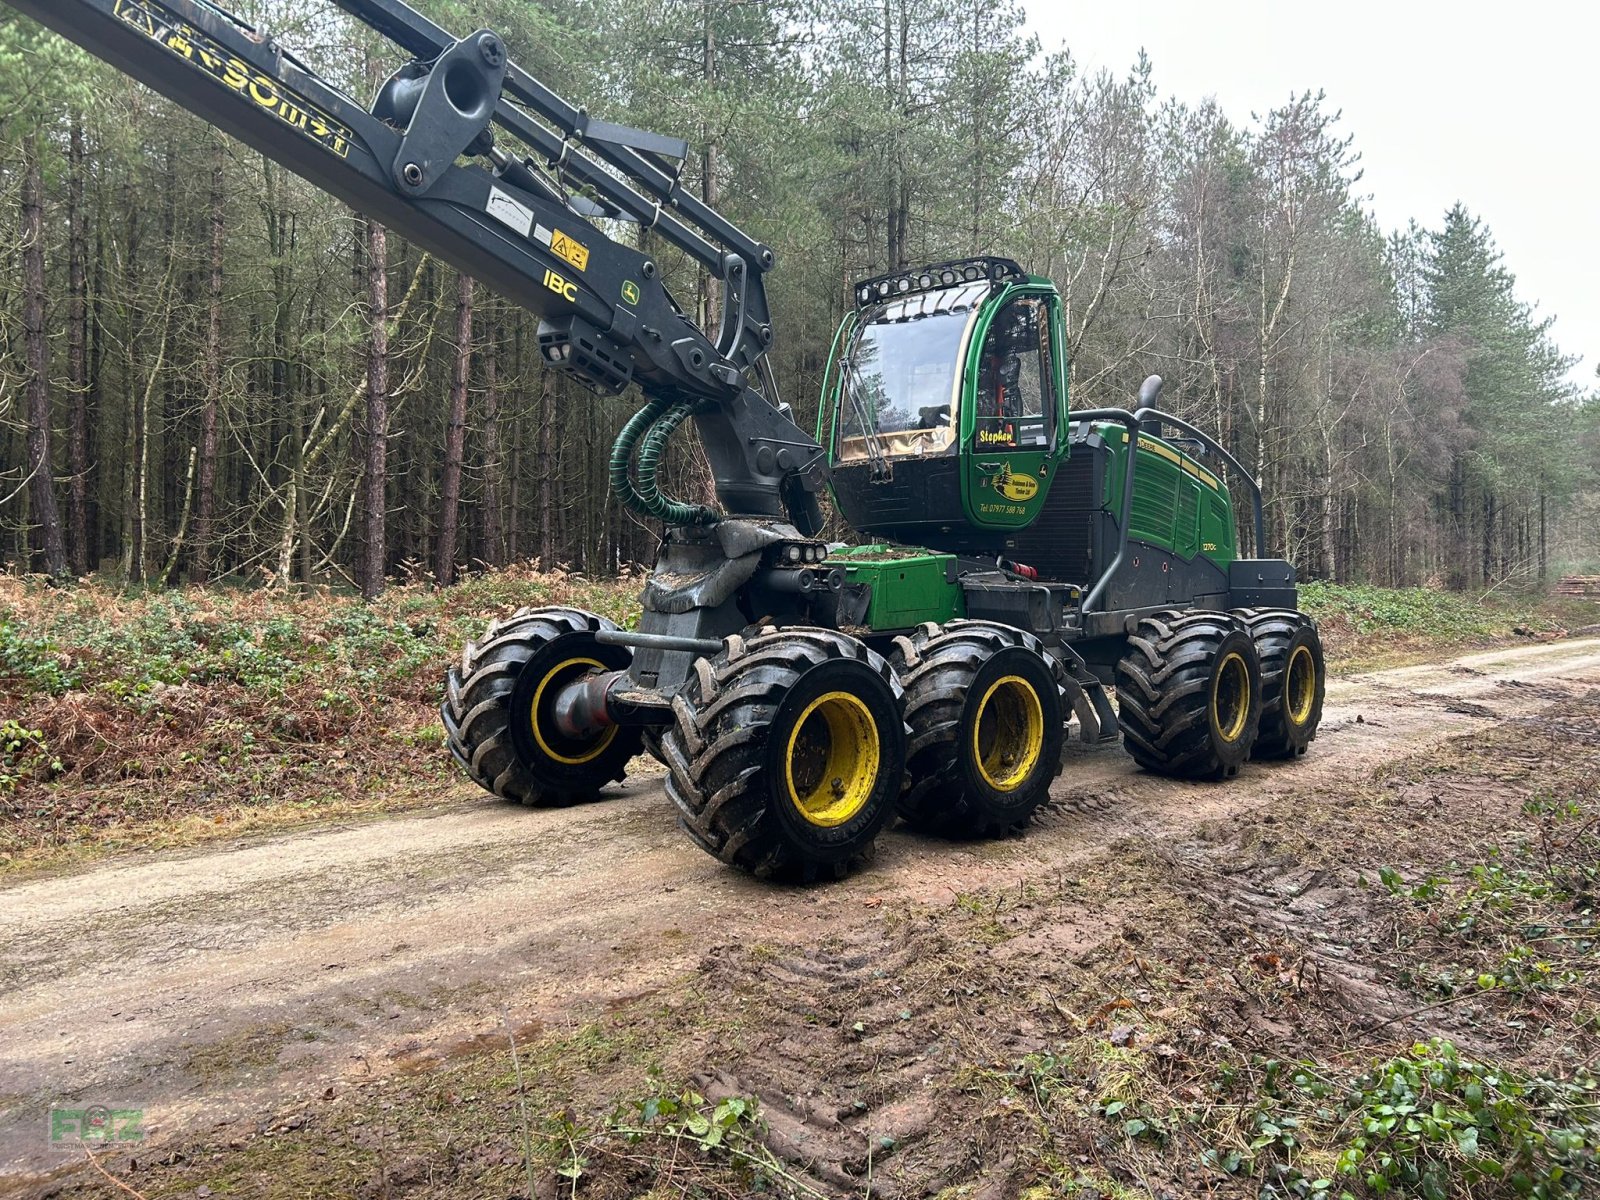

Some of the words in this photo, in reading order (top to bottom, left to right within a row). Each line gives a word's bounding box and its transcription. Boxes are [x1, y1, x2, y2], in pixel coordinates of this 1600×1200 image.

[543, 269, 578, 303] IBC
[980, 429, 1012, 444] Stephen
[1141, 440, 1156, 452] DEERE
